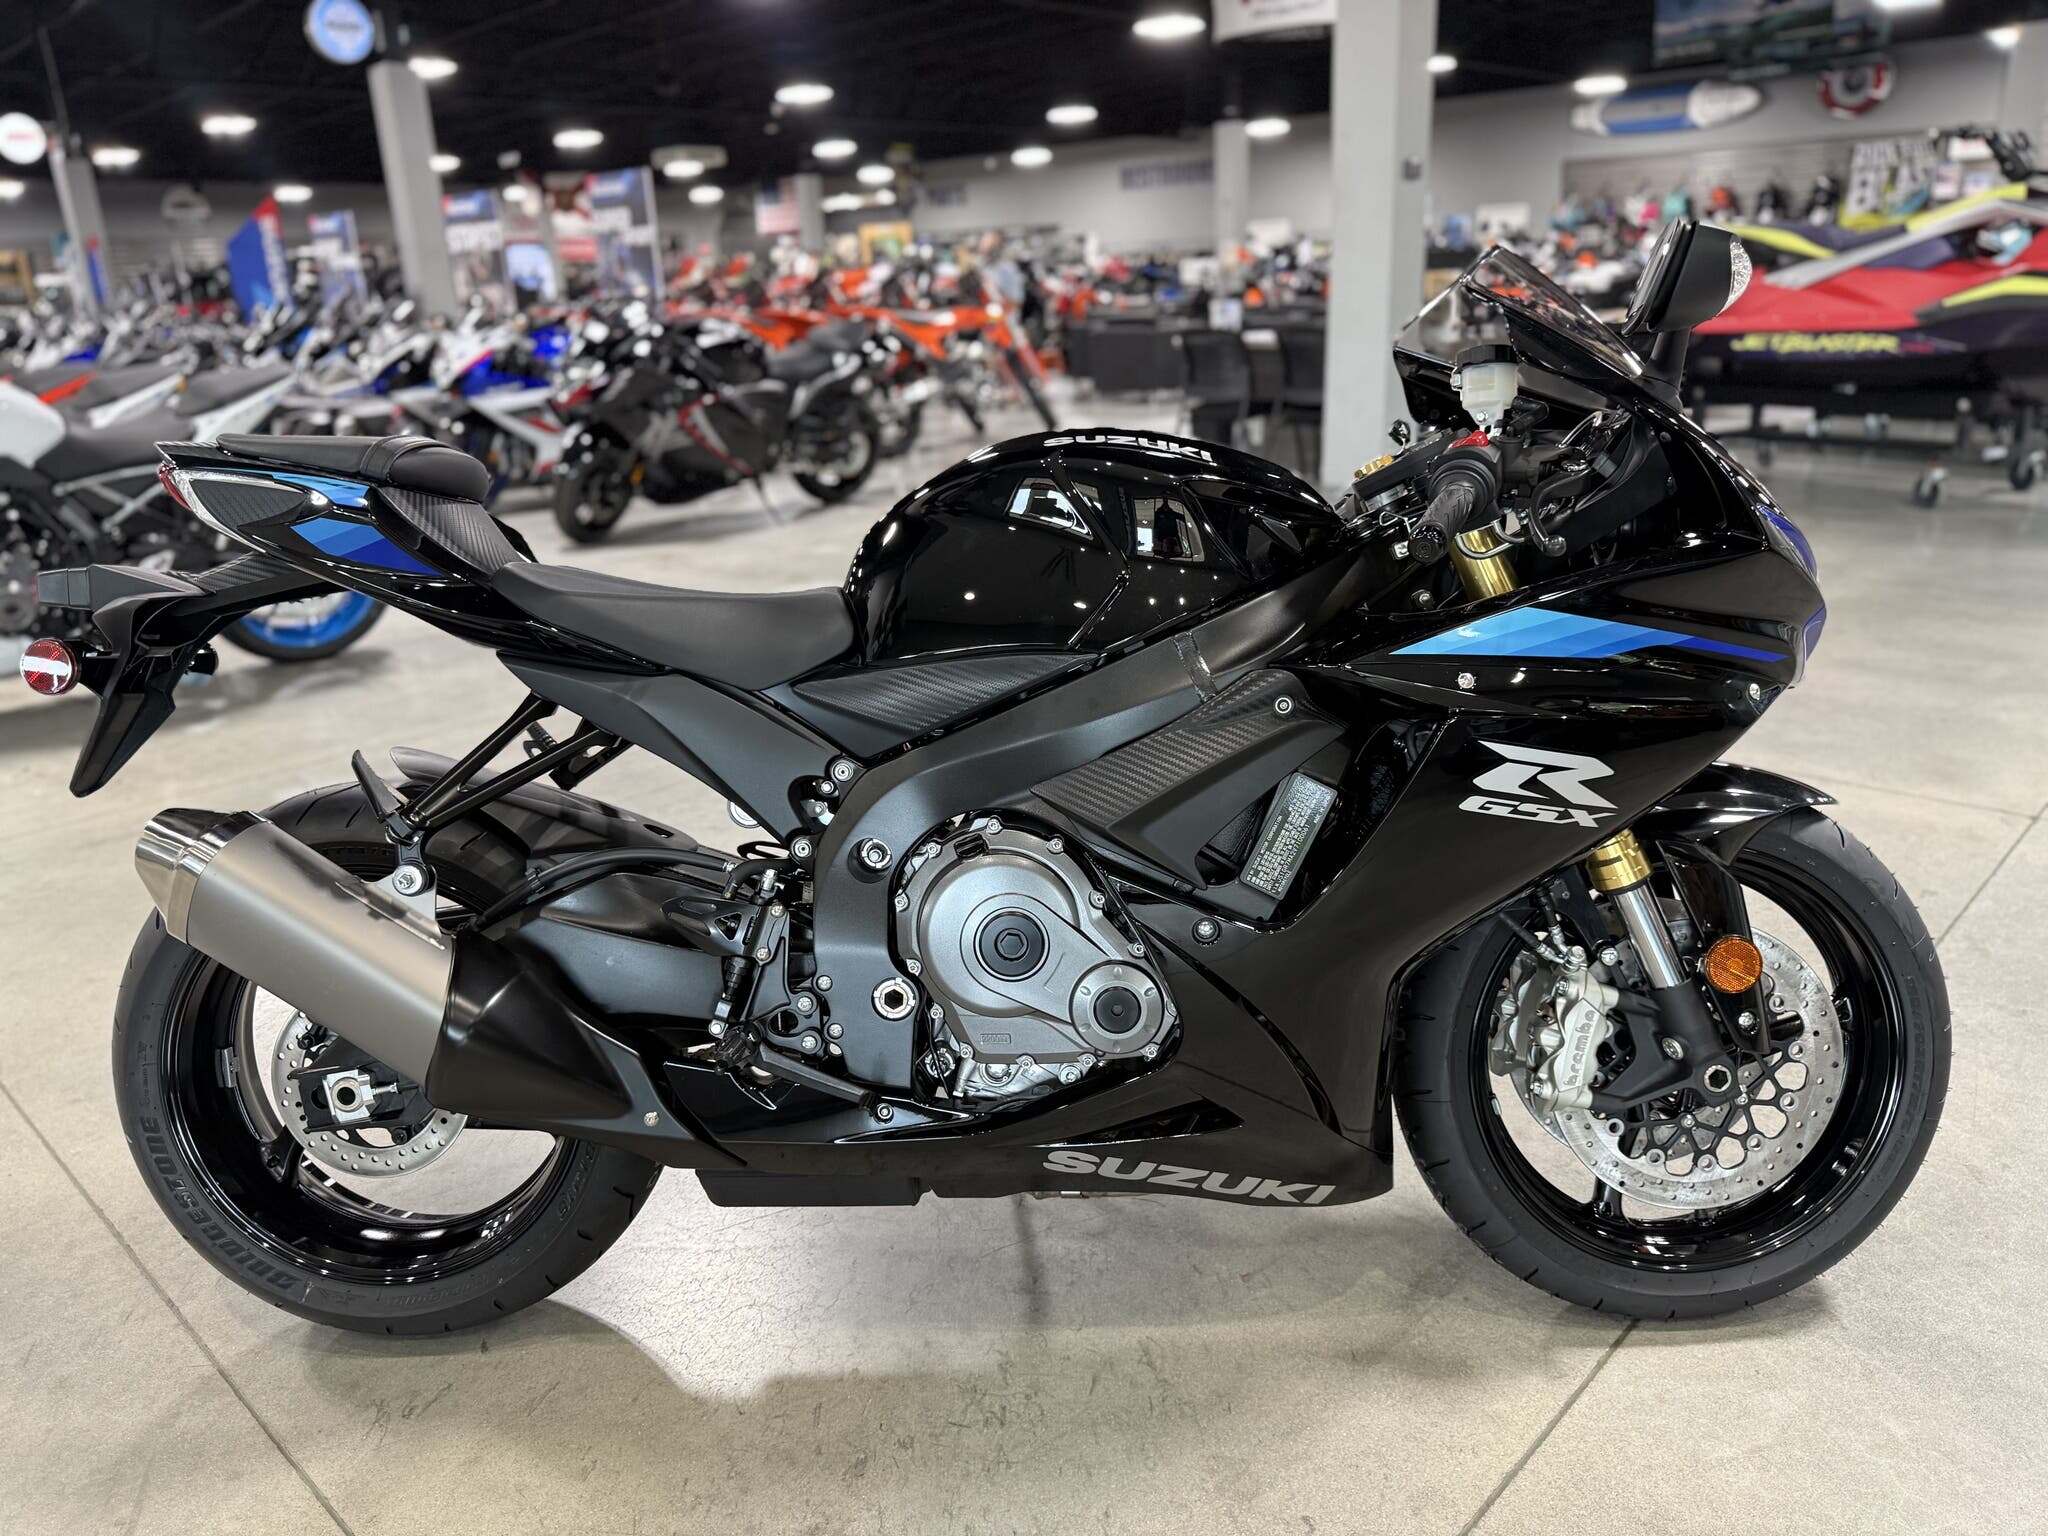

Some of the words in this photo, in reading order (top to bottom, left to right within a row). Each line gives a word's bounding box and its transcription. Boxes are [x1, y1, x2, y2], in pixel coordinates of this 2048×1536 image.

[1043, 435, 1213, 462] SUZUKI
[1472, 740, 1619, 809] R
[1458, 795, 1618, 828] GSX
[1563, 1010, 1597, 1086] brembo
[140, 1116, 298, 1290] BRIDGESTONE
[1042, 1150, 1337, 1205] SUZUKI
